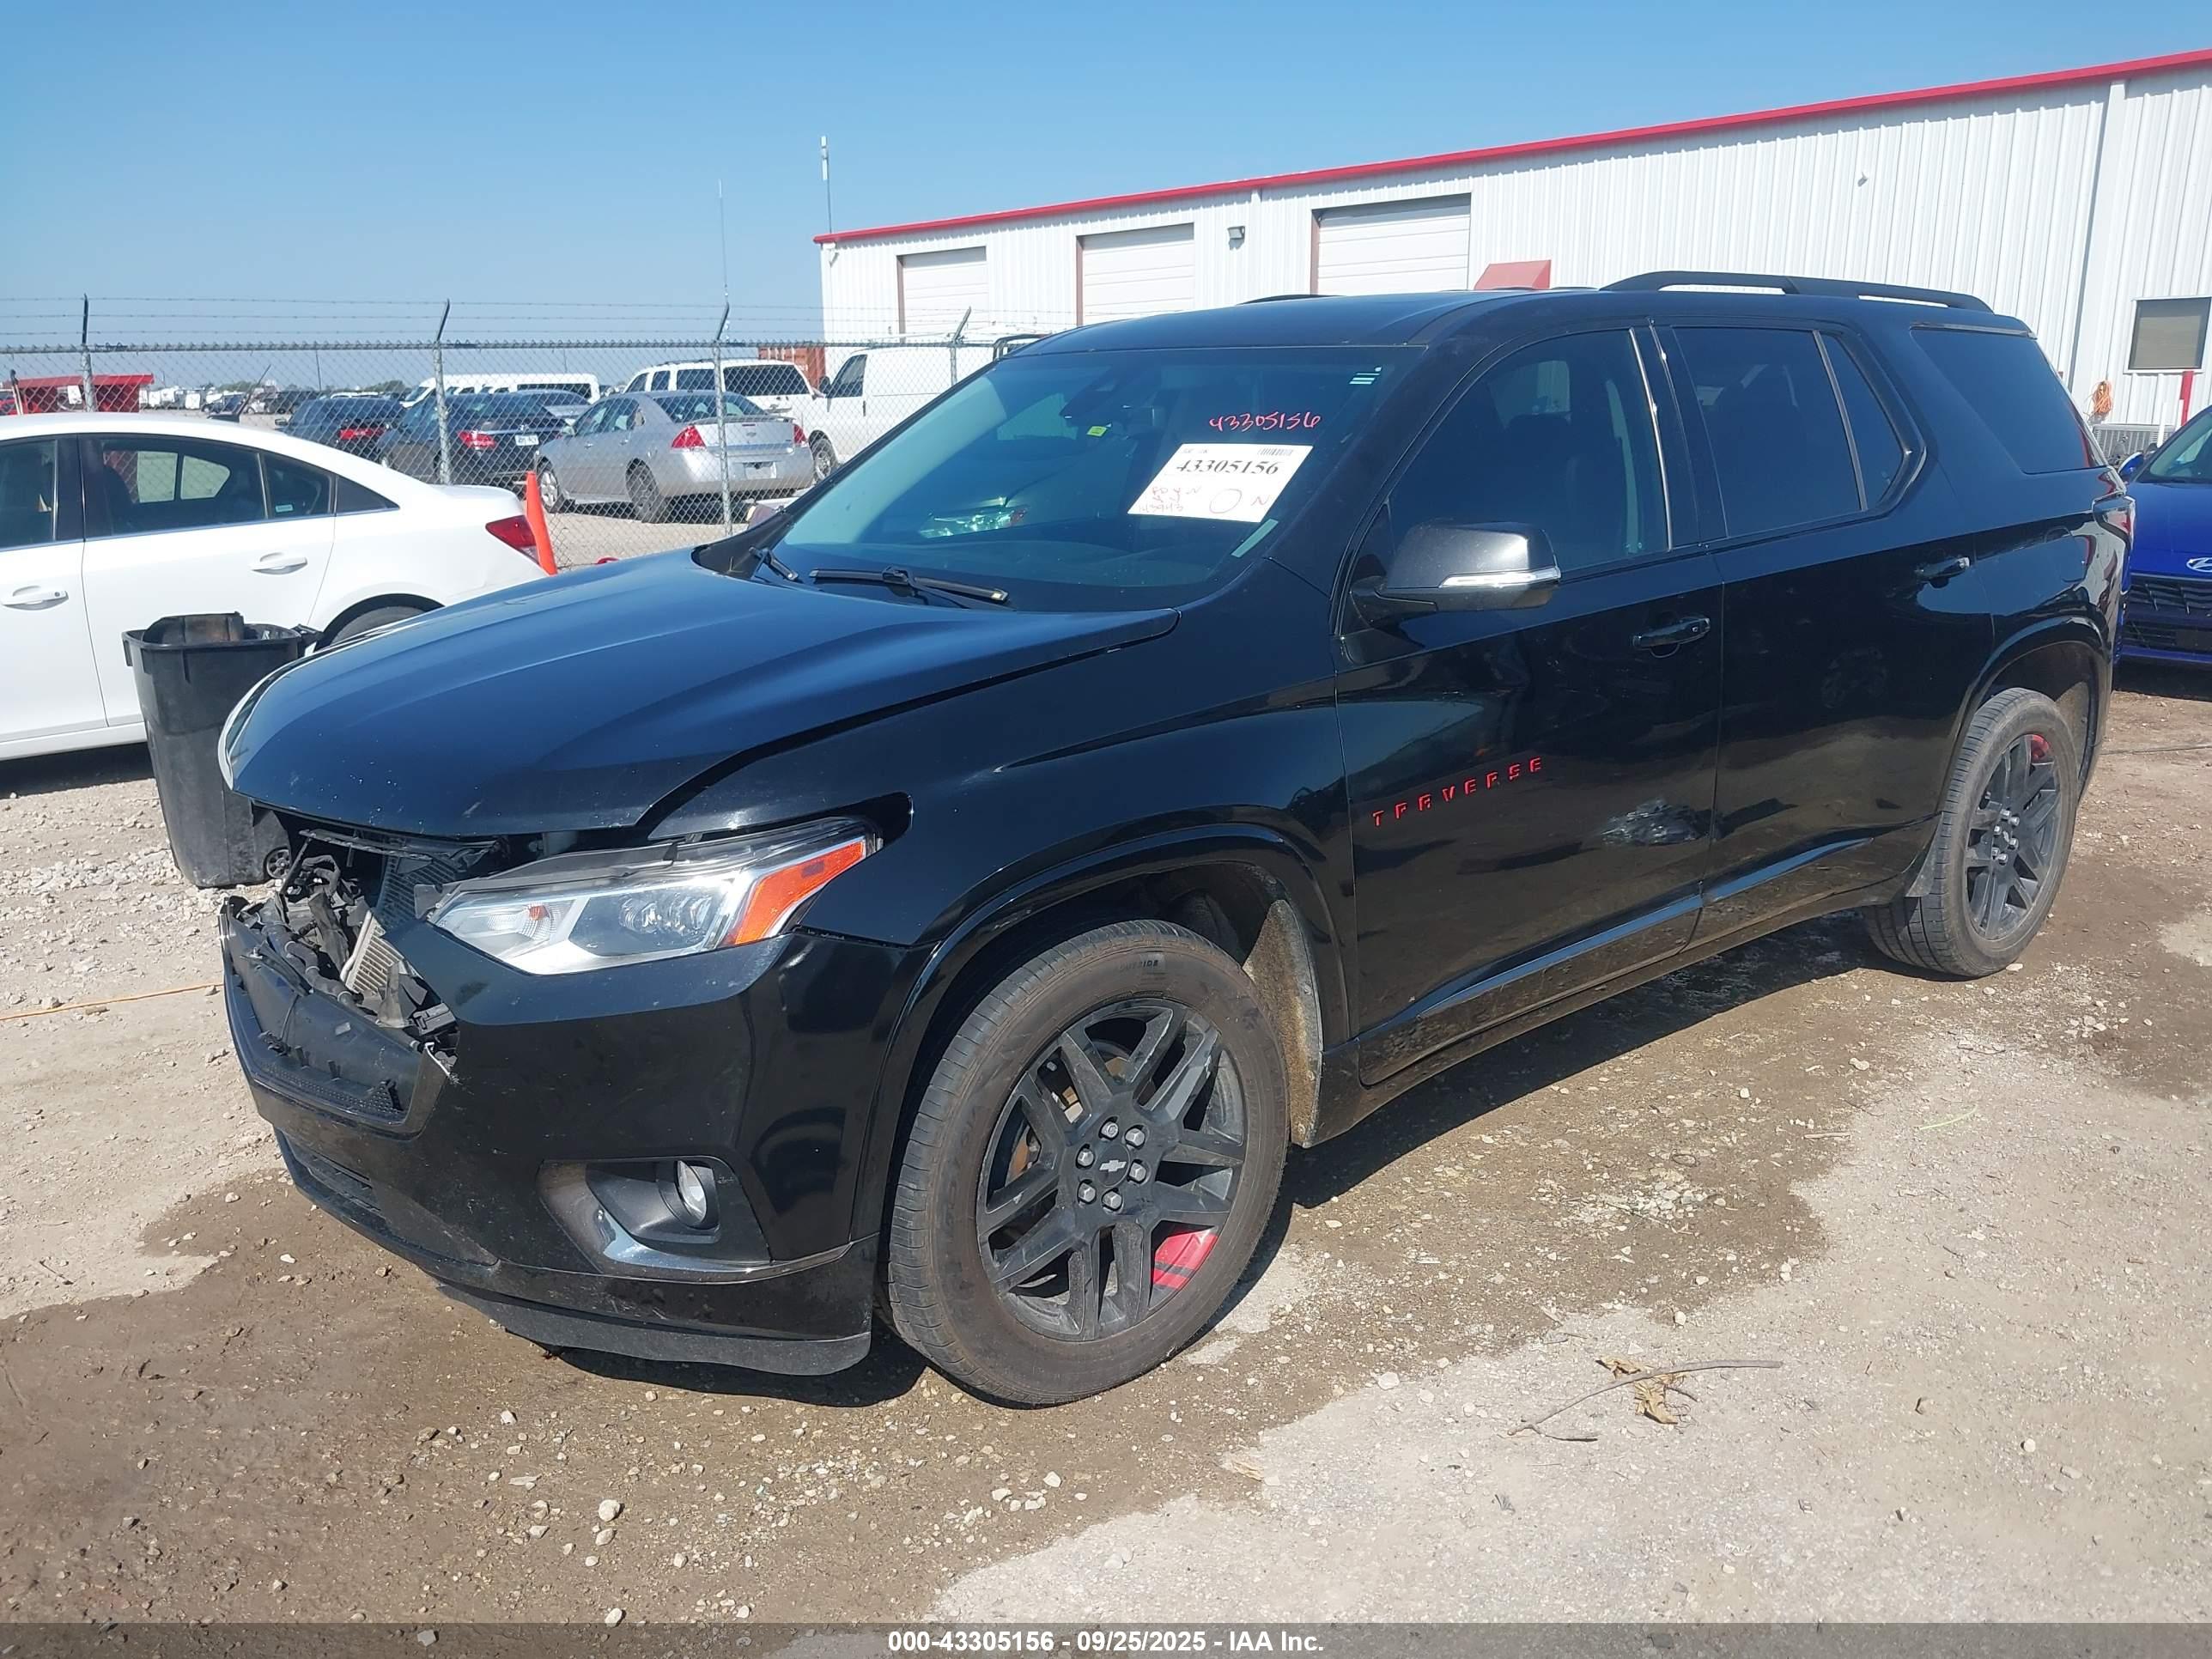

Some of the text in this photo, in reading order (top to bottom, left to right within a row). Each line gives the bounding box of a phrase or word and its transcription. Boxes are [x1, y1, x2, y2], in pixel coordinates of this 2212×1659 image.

[1208, 411, 1321, 432] 43305156
[1176, 459, 1283, 475] 43305156
[1371, 756, 1542, 827] TRAVERSE
